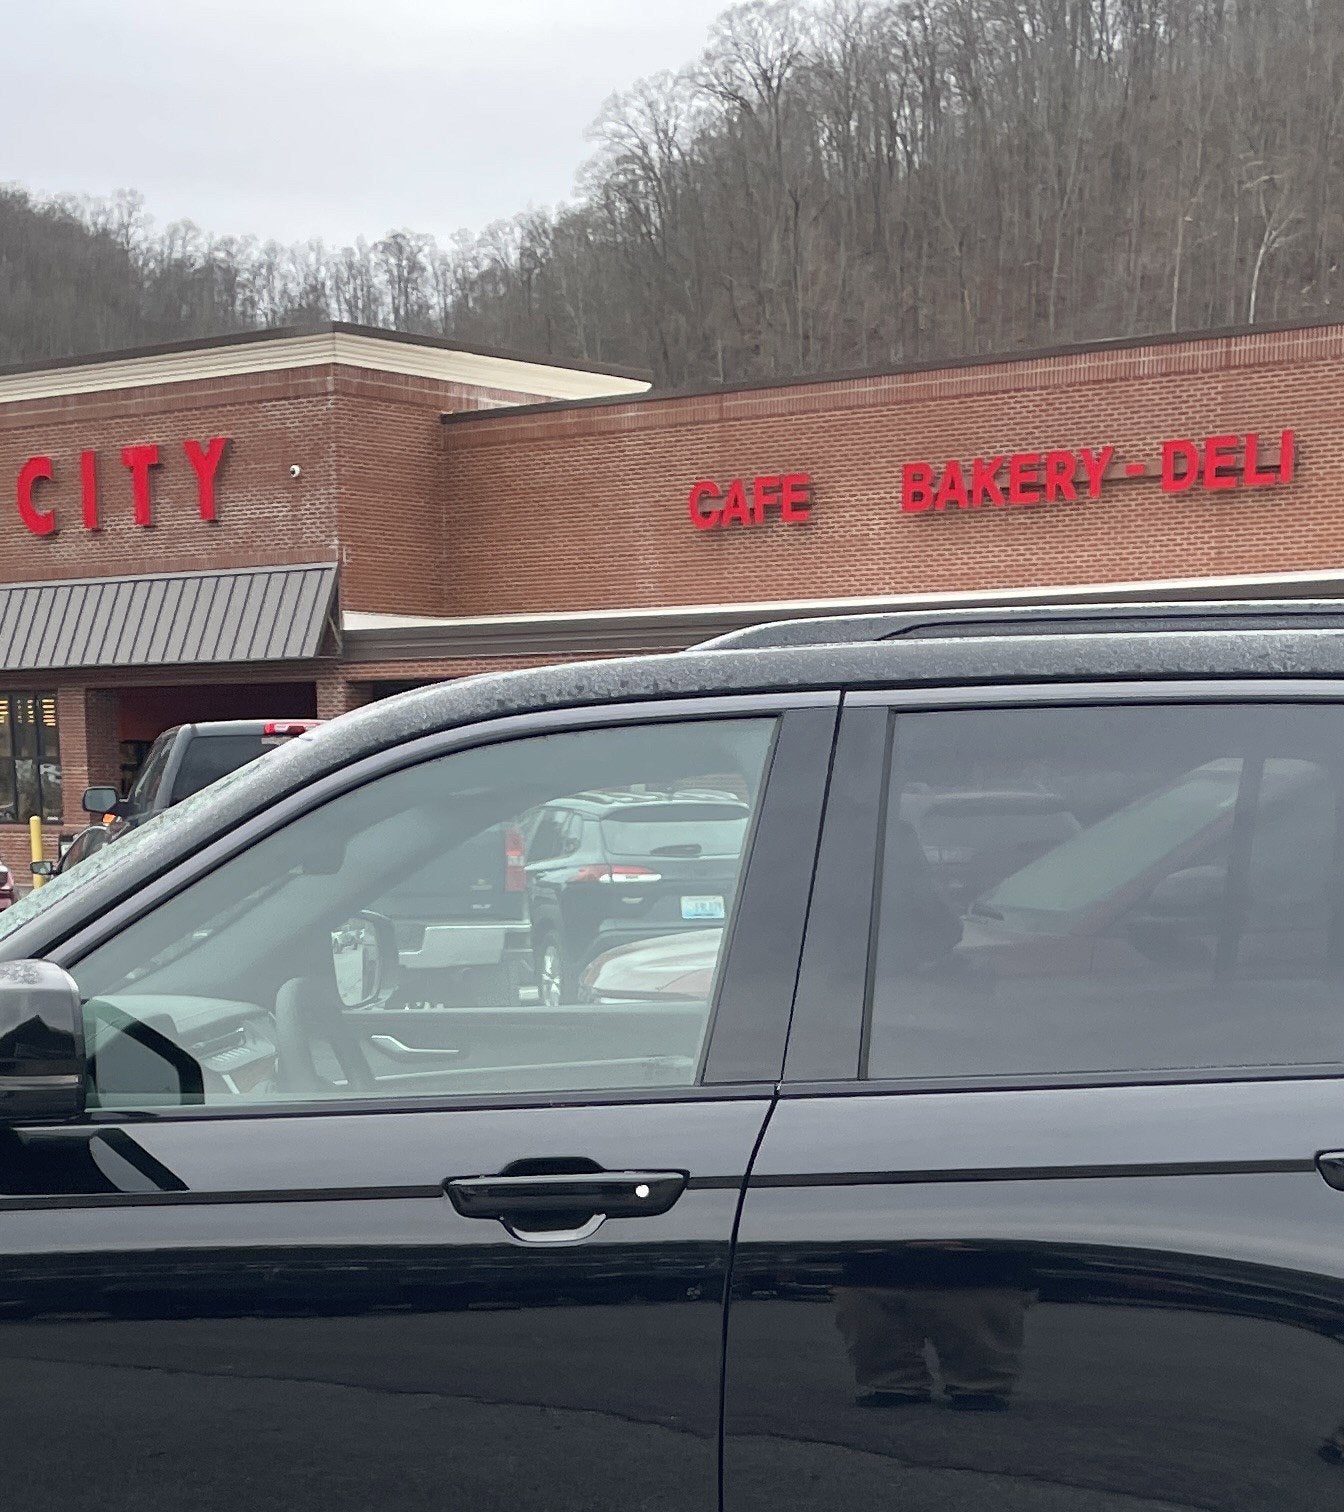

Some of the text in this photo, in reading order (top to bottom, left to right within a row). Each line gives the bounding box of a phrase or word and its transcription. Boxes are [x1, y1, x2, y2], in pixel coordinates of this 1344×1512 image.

[15, 436, 227, 536] CITY
[687, 472, 812, 531] CAFE
[900, 445, 1115, 513] BAKERY
[1159, 428, 1296, 499] DELI
